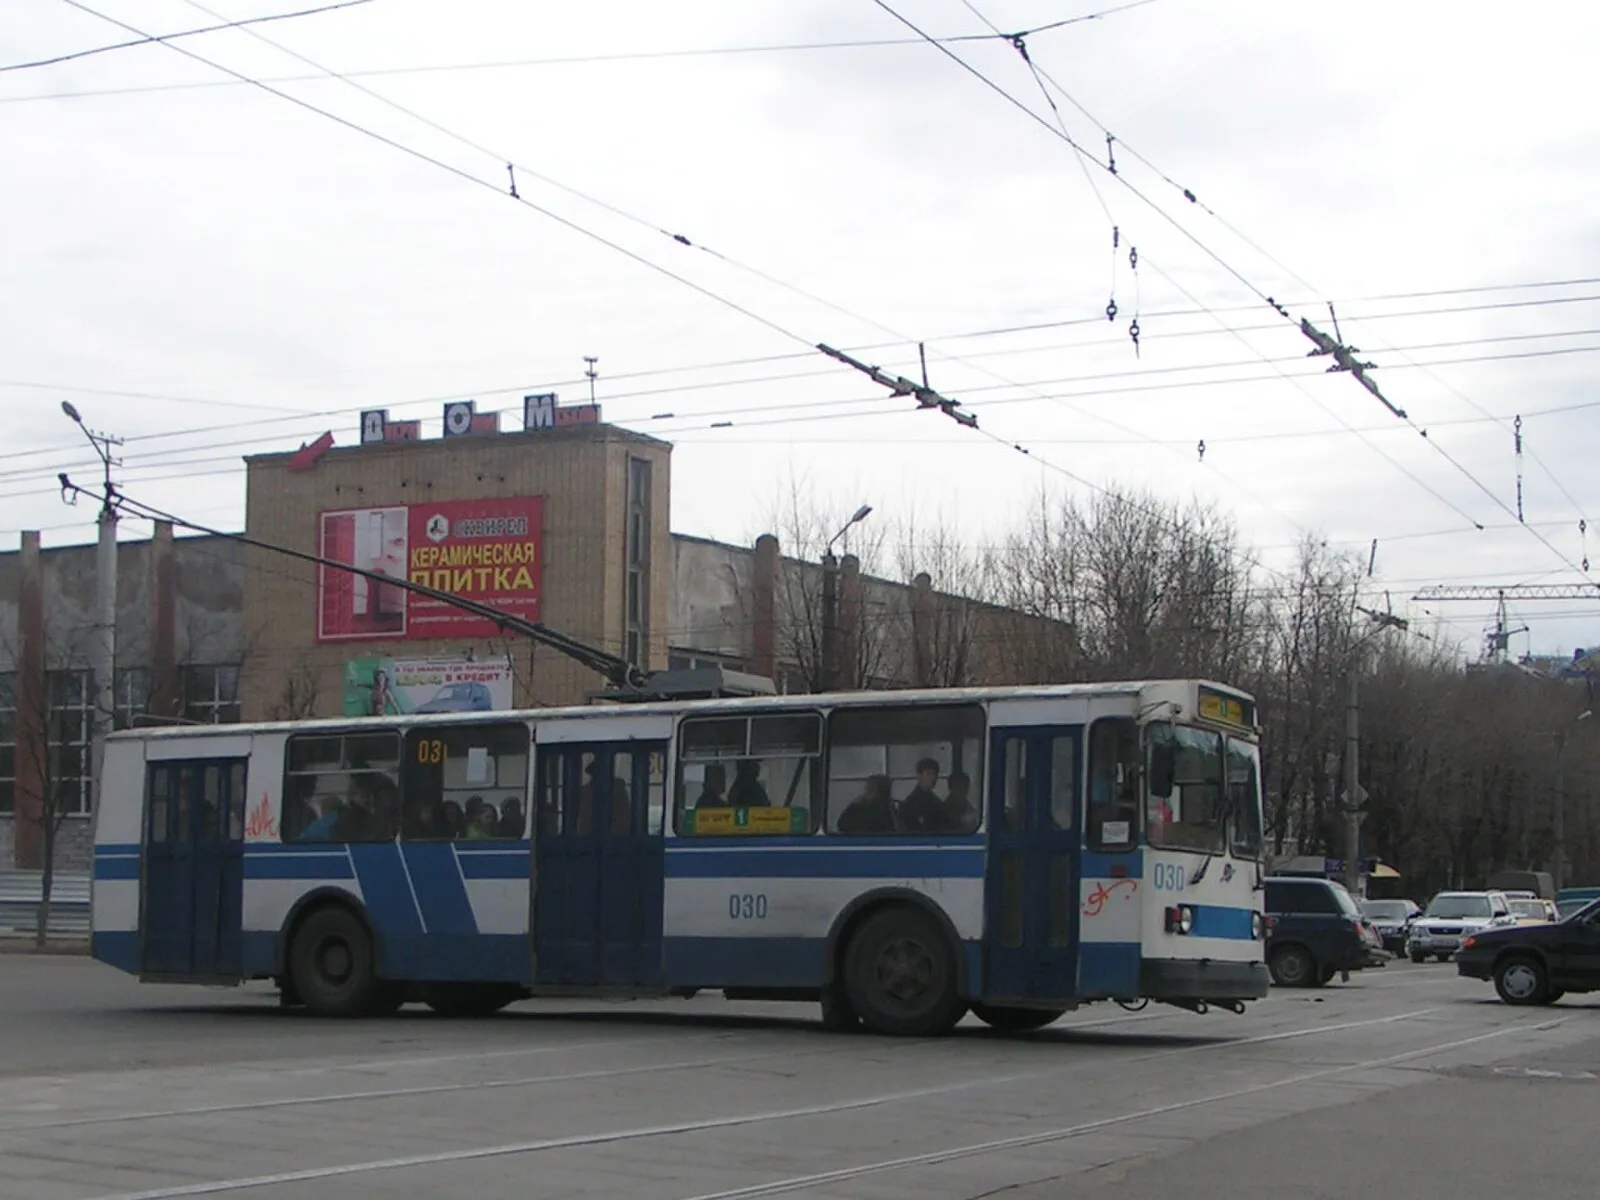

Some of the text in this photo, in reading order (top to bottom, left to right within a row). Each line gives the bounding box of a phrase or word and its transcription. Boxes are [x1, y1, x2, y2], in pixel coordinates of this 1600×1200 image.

[411, 542, 535, 568] КЕРАМИЧЕСКАЯ
[411, 567, 535, 592] ПЛИТКА
[456, 673, 500, 681] КРЕДИТ
[737, 808, 745, 825] 1
[1154, 863, 1185, 891] 030
[729, 895, 768, 919] 030
